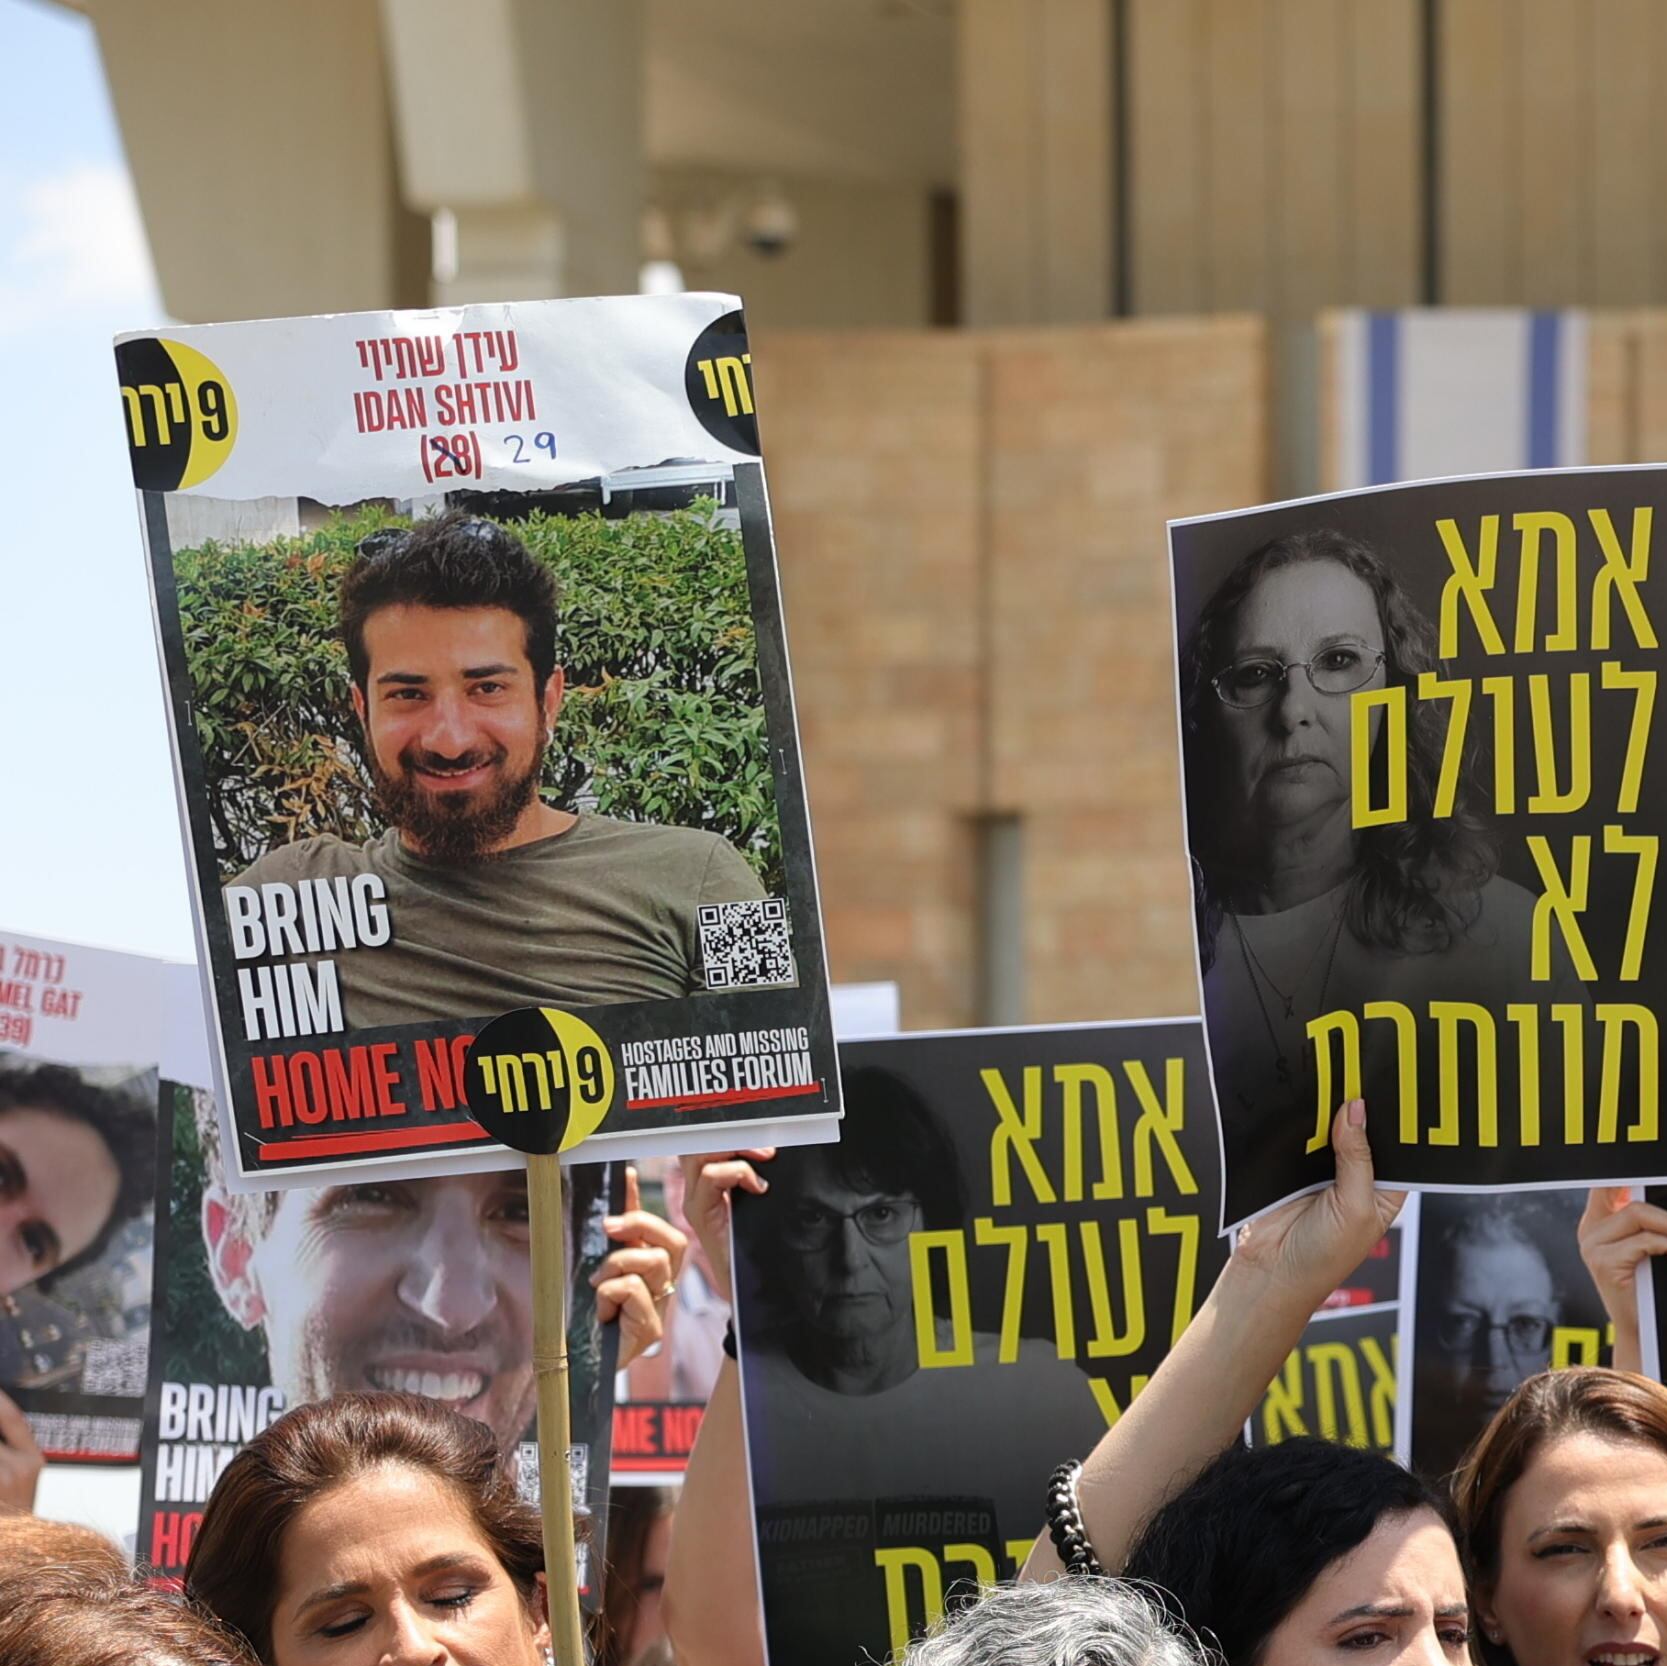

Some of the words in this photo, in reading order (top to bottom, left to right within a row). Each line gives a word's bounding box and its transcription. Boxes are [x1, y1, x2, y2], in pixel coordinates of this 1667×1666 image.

[356, 336, 445, 381] שתיוי
[451, 330, 519, 379] עידן
[197, 380, 230, 442] 9
[354, 387, 428, 433] IDAN
[435, 380, 536, 426] SHTIVI
[421, 431, 482, 483] (28)
[503, 431, 557, 465] 29
[1436, 507, 1659, 660] אמא
[1350, 661, 1657, 830] לעולם
[224, 873, 391, 960] BRING
[1526, 825, 1660, 982] לא
[238, 961, 346, 1041] HIM
[579, 1046, 602, 1104] 9
[621, 1037, 701, 1066] HOSTAGES
[704, 1033, 738, 1058] AND
[739, 1027, 809, 1055] MISSING
[624, 1060, 729, 1101] FAMILIES
[734, 1052, 815, 1094] FORUM
[1306, 1001, 1659, 1156] מוותרת
[251, 1042, 407, 1129] HOME
[478, 1049, 567, 1114] ירחי
[980, 1058, 1199, 1206] אמא
[909, 1207, 1199, 1368] לעולם
